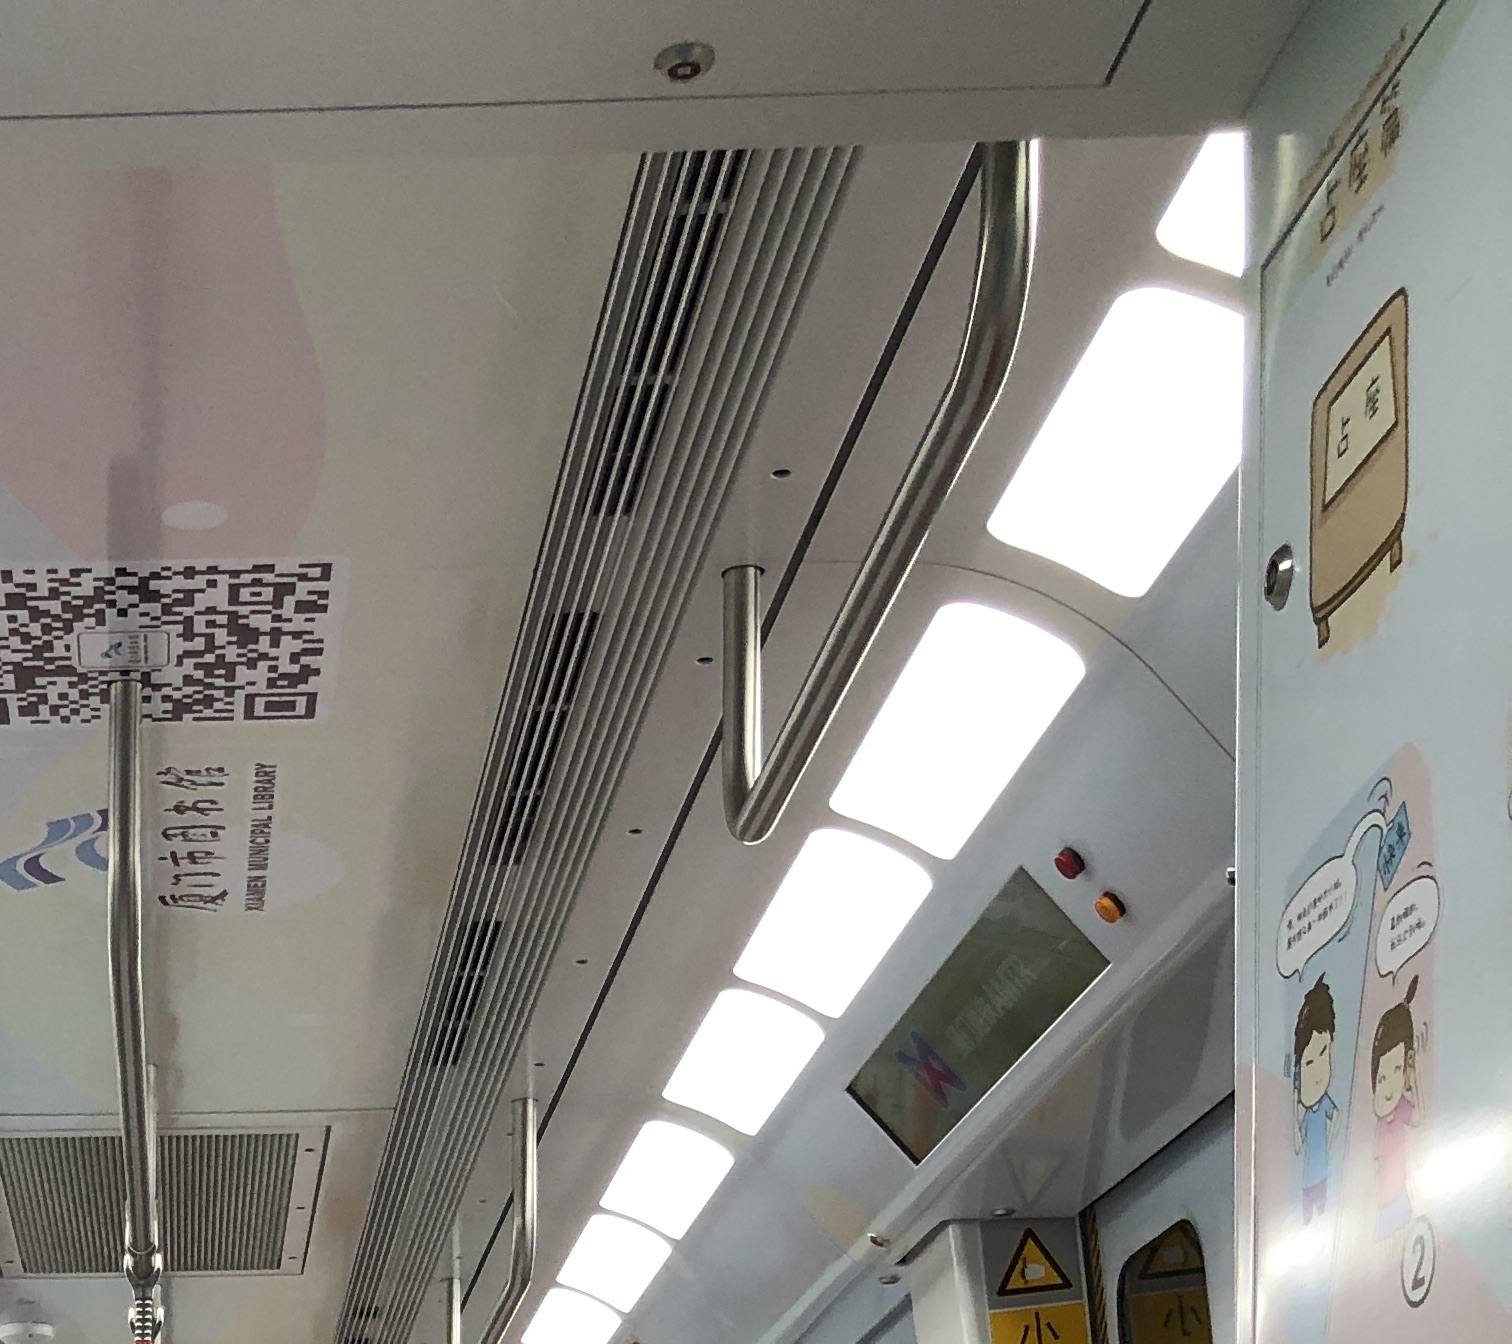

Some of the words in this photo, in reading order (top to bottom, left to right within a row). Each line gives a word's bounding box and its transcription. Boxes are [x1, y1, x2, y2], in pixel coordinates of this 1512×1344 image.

[250, 762, 278, 811] LIBRARY
[246, 814, 274, 876] MUNICIPAL
[244, 877, 267, 912] XIAMEN
